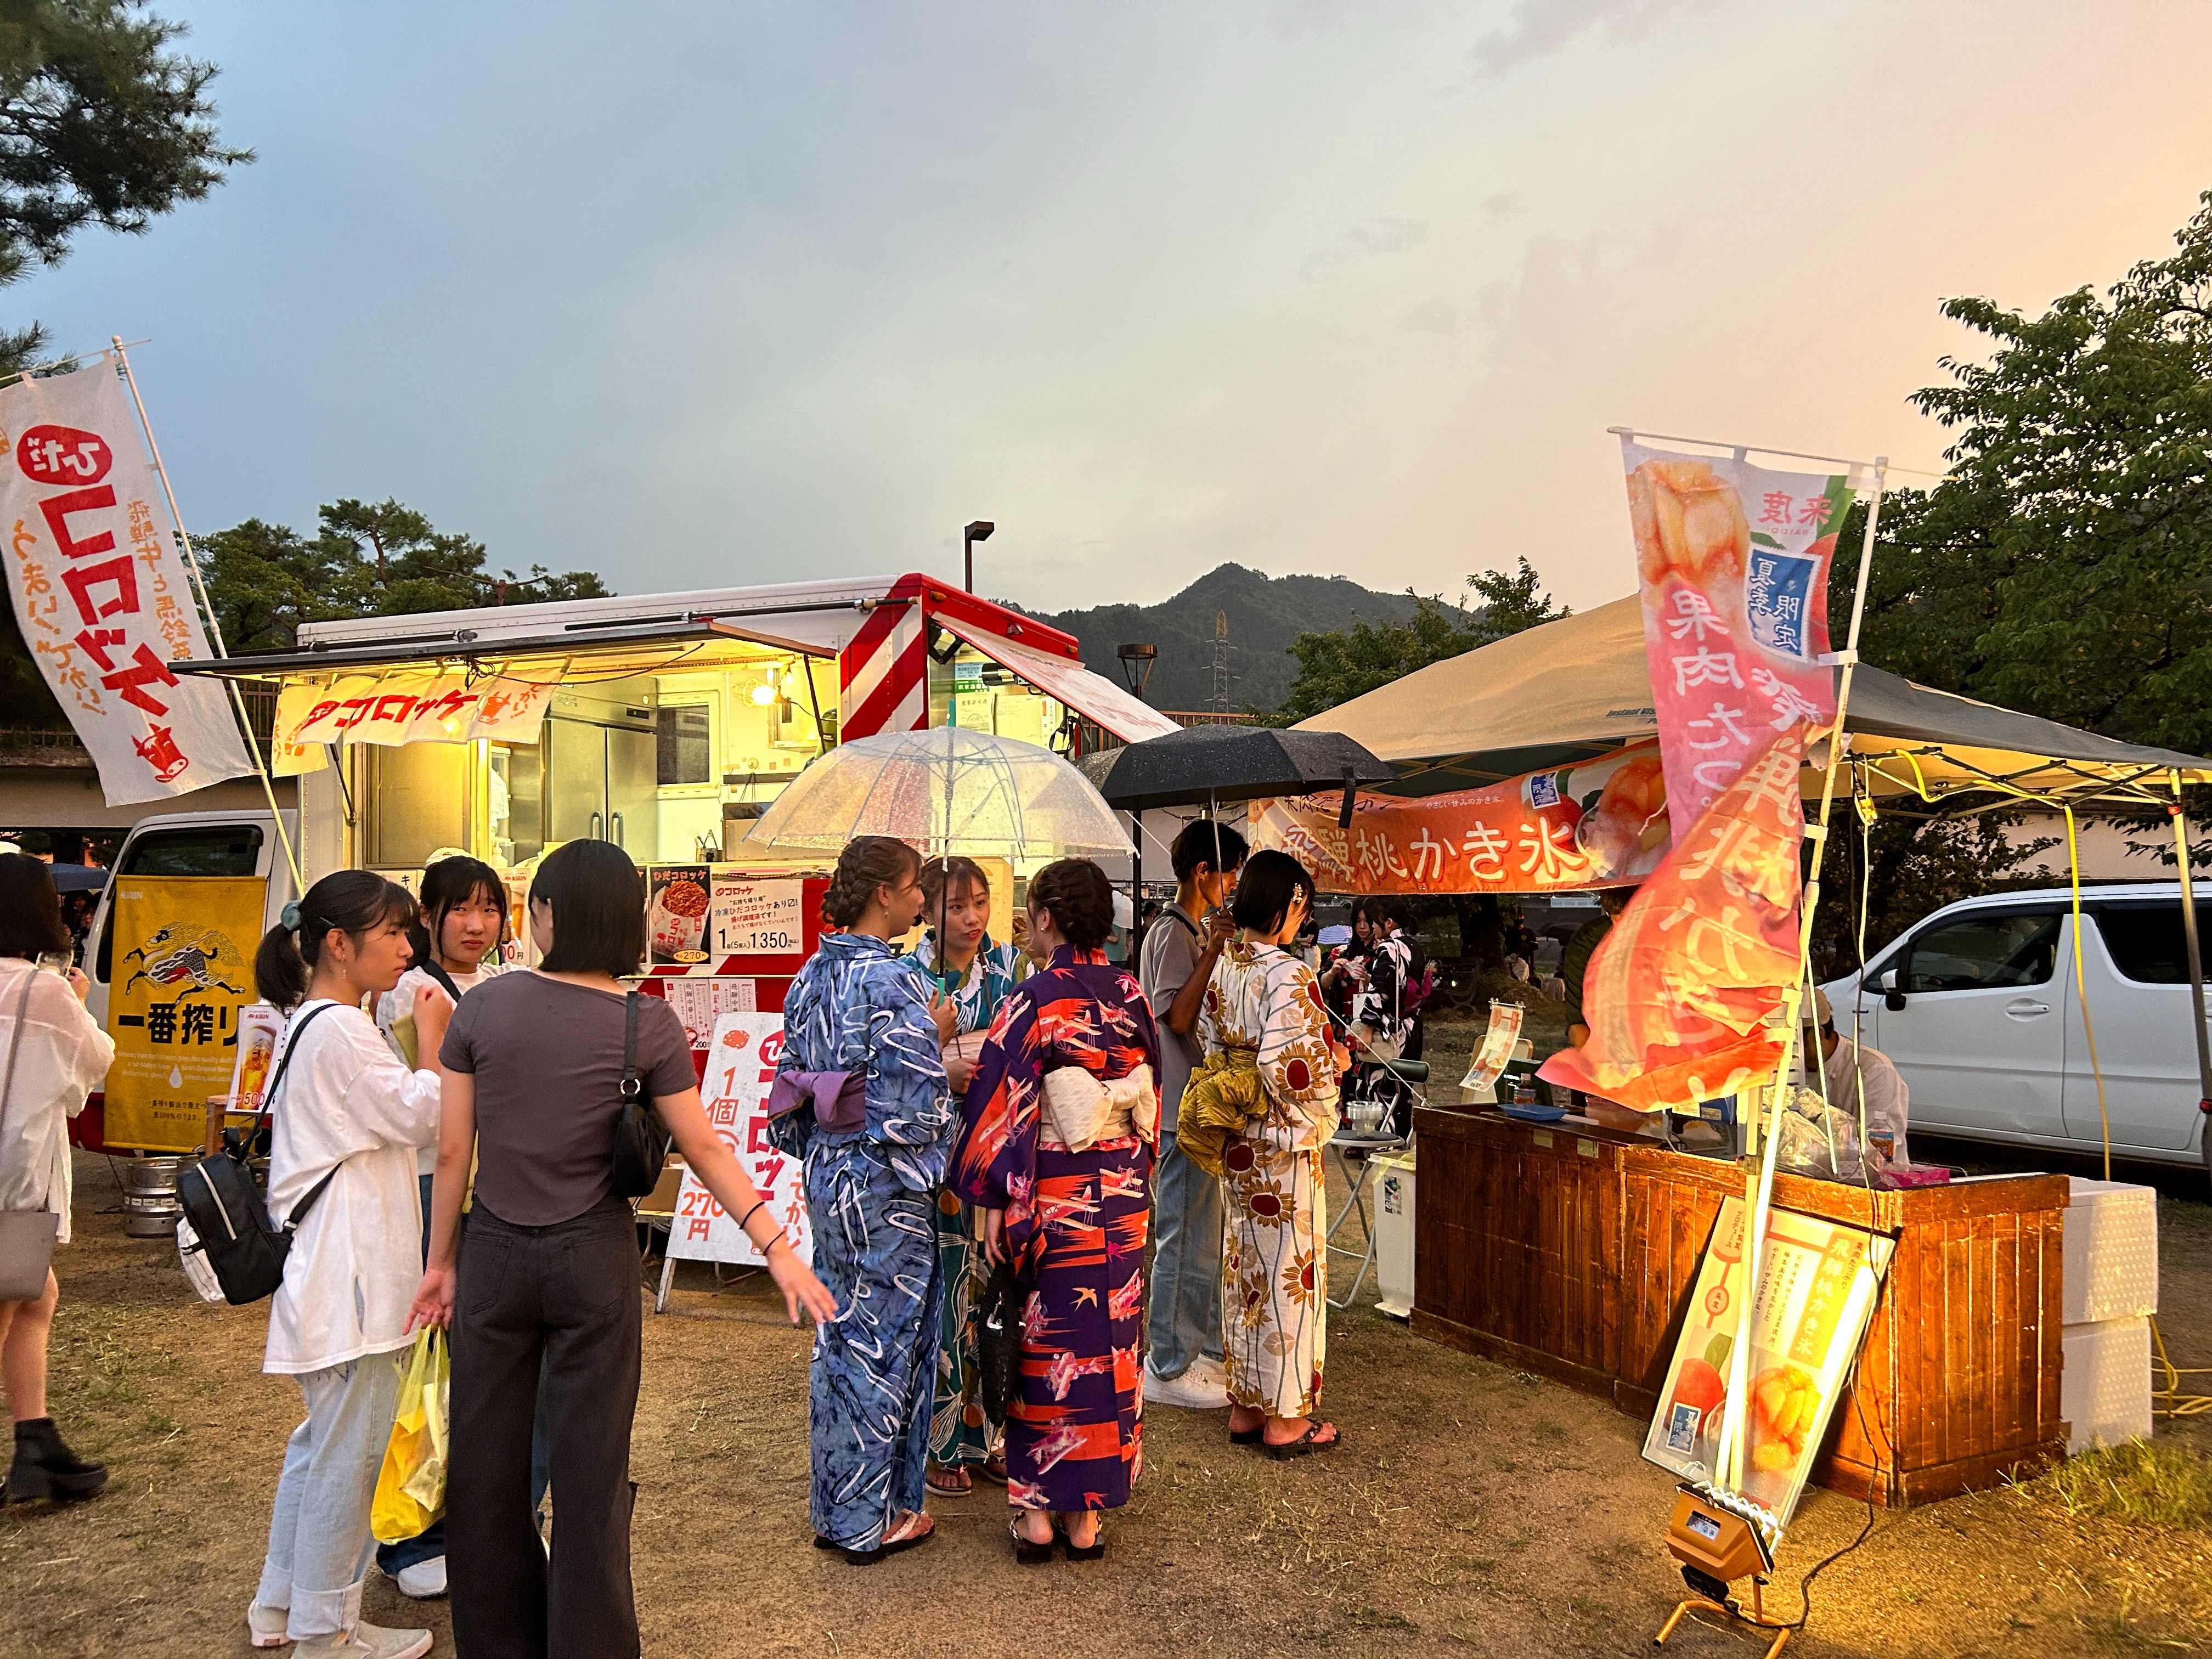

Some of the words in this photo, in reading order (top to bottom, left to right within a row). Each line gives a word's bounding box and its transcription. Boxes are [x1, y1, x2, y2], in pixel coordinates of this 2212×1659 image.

[334, 689, 479, 730] コロッケ
[1425, 795, 1504, 809] やさしい甘みのかき氷。
[1282, 817, 1584, 882] 飛騨桃かき氷
[653, 870, 707, 881] ひだコロッケ
[118, 1003, 245, 1047] 一番搾り
[244, 1092, 265, 1105] 500
[1841, 1242, 1864, 1290] 果肉たっぷり
[1795, 1238, 1850, 1356] 飛騨桃かき氷
